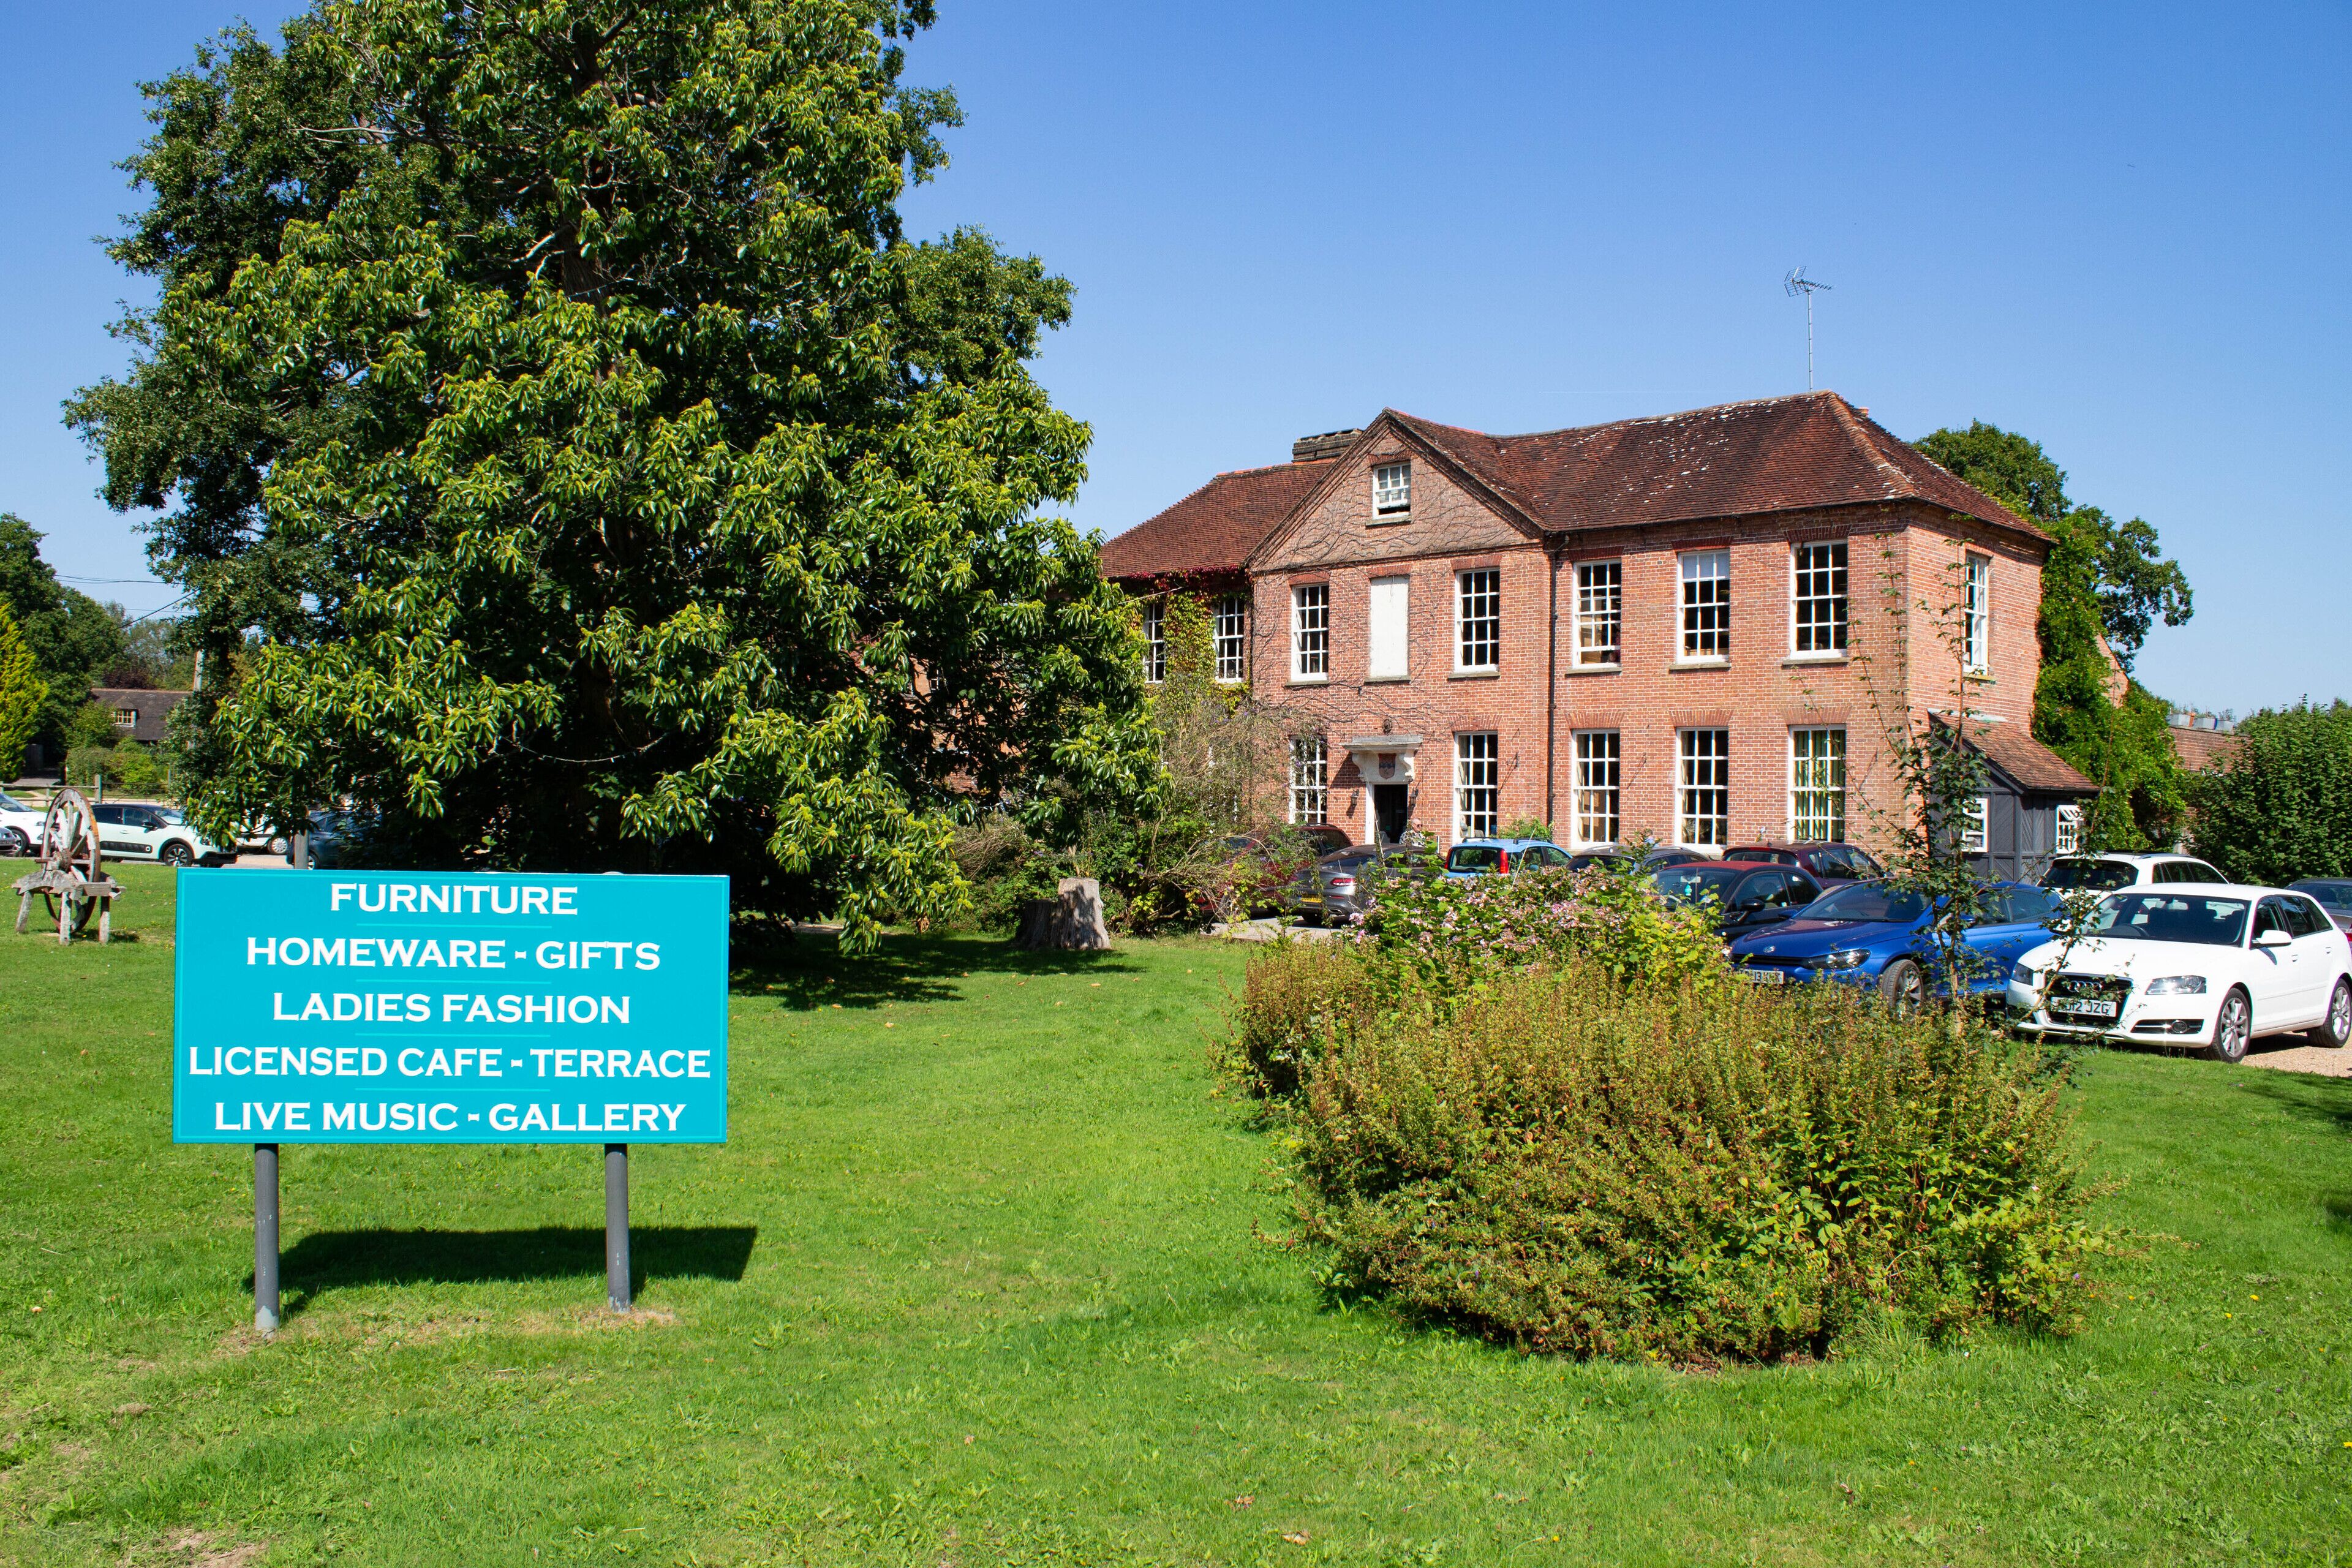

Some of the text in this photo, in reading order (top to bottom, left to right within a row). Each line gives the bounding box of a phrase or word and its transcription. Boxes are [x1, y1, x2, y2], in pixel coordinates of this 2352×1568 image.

[331, 883, 578, 915] FURNITURE
[247, 937, 506, 968] HOMEWARE
[535, 940, 660, 971] GIFTS
[273, 992, 630, 1023] LADIES FASHION
[2086, 1001, 2109, 1015] JZG
[189, 1046, 387, 1076] LICENSED
[398, 1048, 502, 1077] CAFE
[530, 1049, 710, 1078] TERRACE
[215, 1102, 311, 1131] LIVE
[322, 1102, 458, 1131] MUSIC
[489, 1103, 686, 1131] GALLERY
